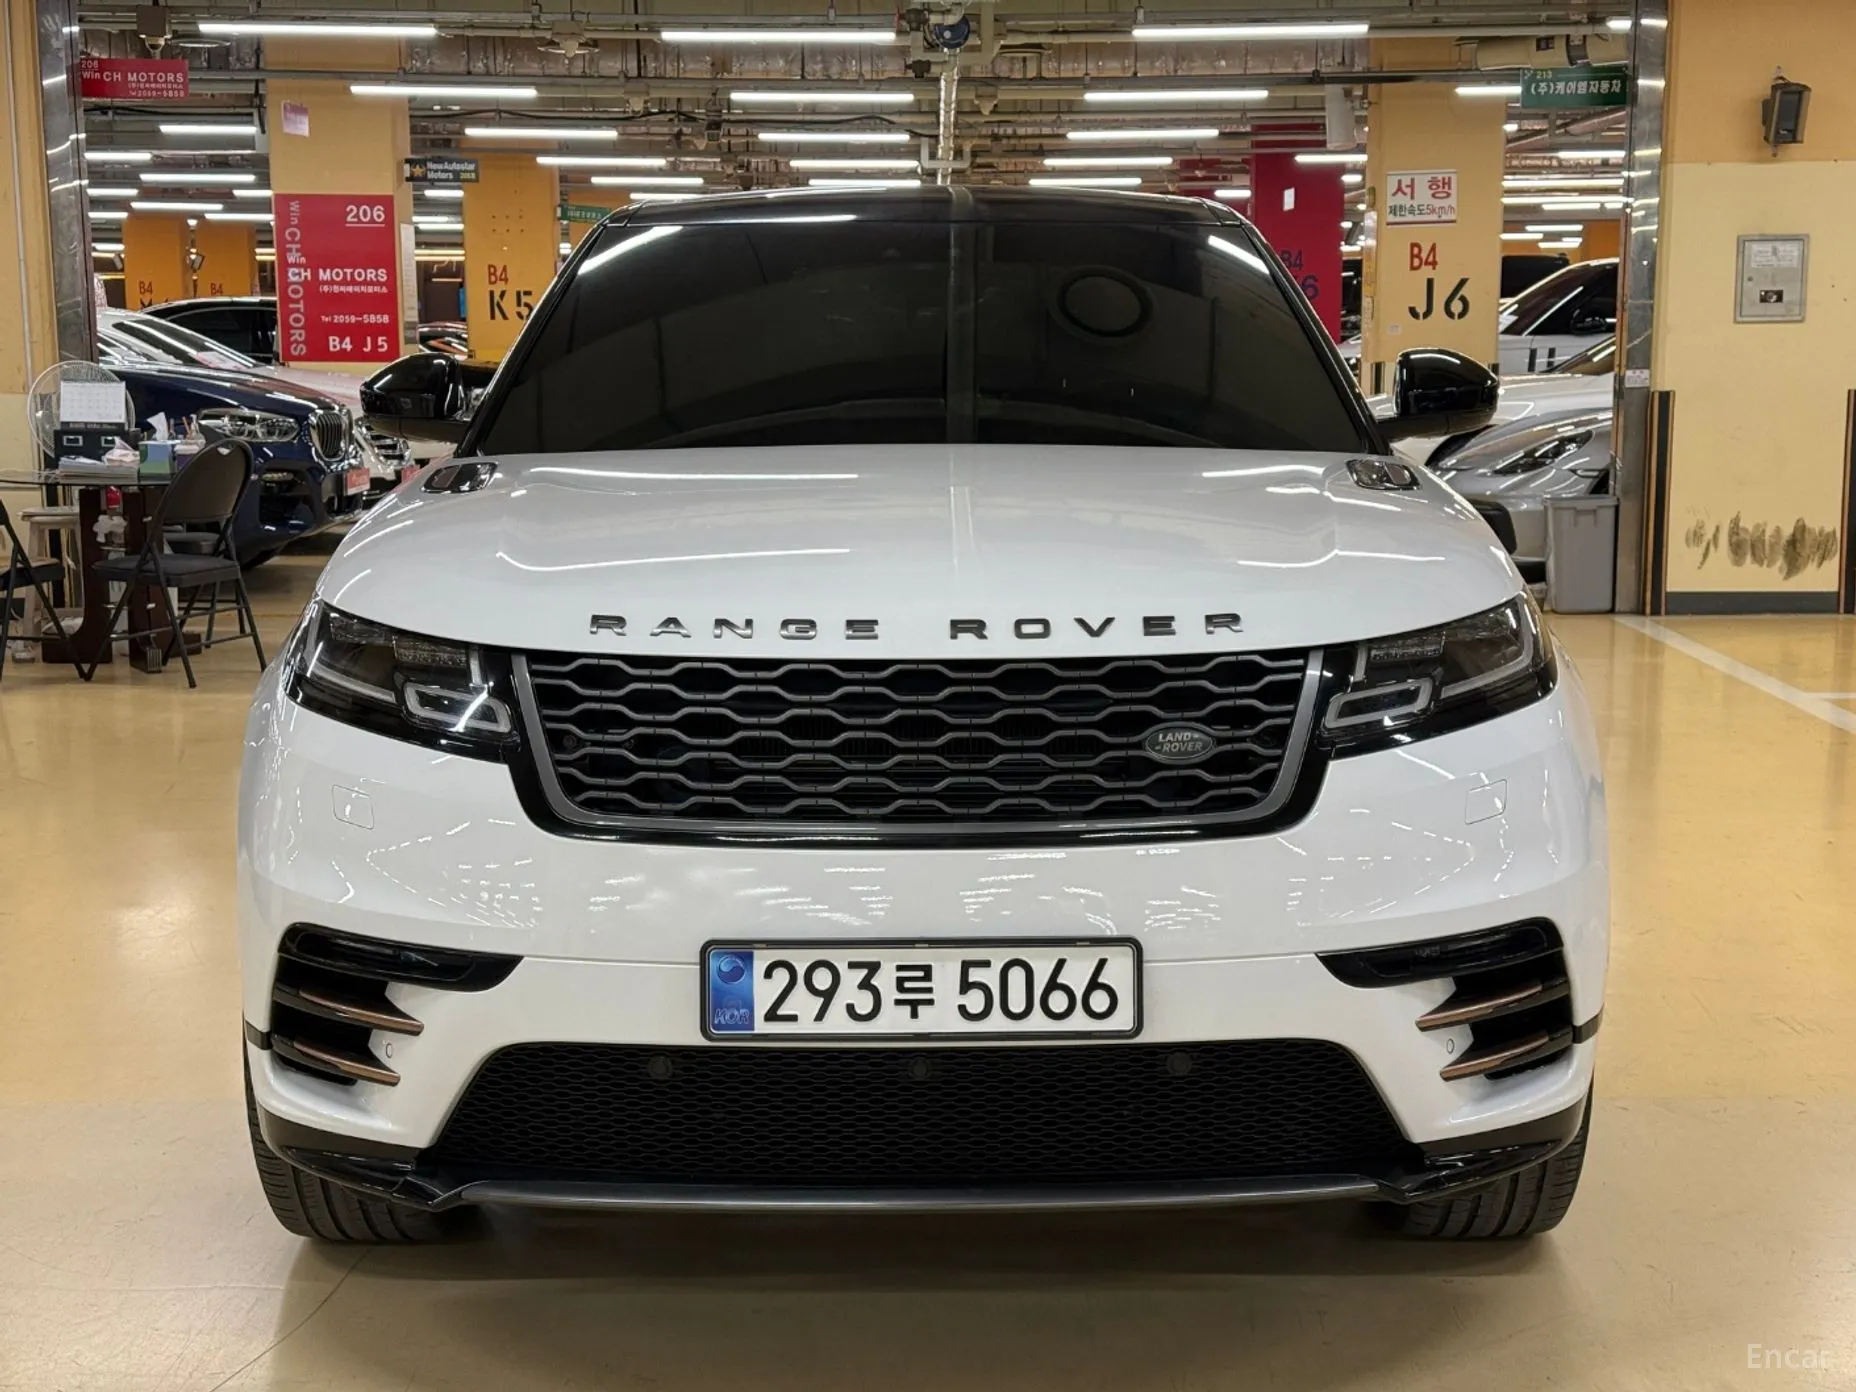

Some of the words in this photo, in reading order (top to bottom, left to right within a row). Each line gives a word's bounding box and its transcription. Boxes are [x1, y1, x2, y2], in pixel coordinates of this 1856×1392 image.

[82, 70, 100, 79] Win
[103, 72, 121, 81] CH
[128, 72, 184, 82] MOTORS
[346, 205, 385, 222] 206
[287, 254, 306, 264] Win
[1410, 242, 1438, 271] B4
[288, 268, 311, 281] CH
[319, 268, 388, 281] MOTORS
[487, 264, 509, 285] B4
[139, 281, 153, 295] B4
[210, 283, 223, 295] B4
[333, 315, 389, 324] 2059-5858
[329, 336, 352, 352] B4
[589, 614, 880, 641] RANGE
[949, 612, 1243, 641] ROVER
[1159, 731, 1191, 742] LAND
[1162, 741, 1203, 753] ROVER
[763, 958, 935, 1022] 293루
[957, 957, 1119, 1022] 5066
[713, 1008, 750, 1025] KOR
